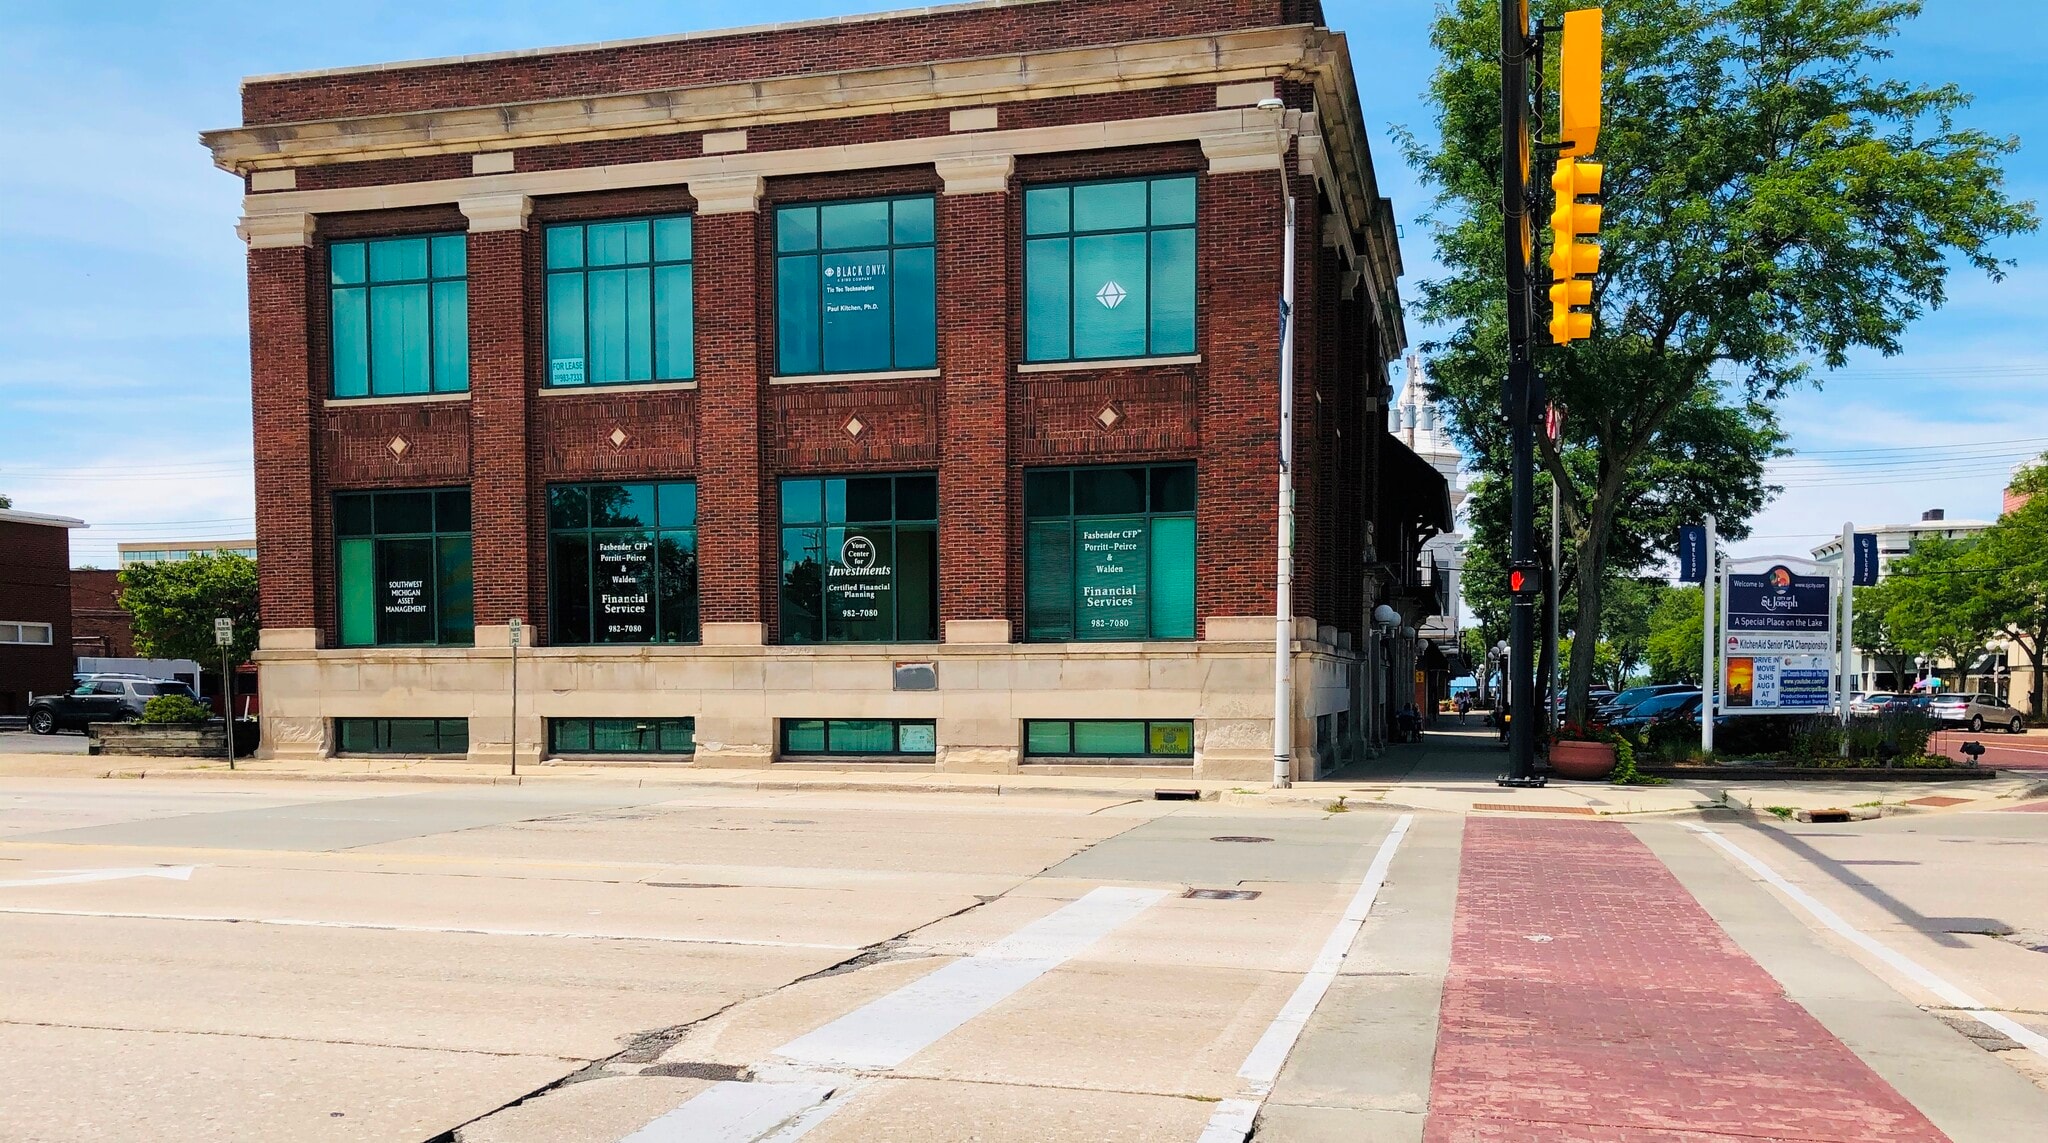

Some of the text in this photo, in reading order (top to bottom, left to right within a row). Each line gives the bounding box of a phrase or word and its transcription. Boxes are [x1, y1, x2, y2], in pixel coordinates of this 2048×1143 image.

[836, 264, 886, 277] BLACK ONYX
[553, 361, 583, 371] FOR LEASE
[1083, 531, 1120, 540] Fasbender
[599, 543, 632, 551] Fasbender
[1084, 543, 1137, 552] Porritt-Peirce
[600, 554, 647, 562] Porritt-Peirce
[1106, 553, 1113, 562] &
[621, 564, 627, 573] &
[828, 566, 891, 576] Investments
[1096, 564, 1124, 573] Walden
[611, 575, 636, 583] Walden
[389, 581, 423, 589] SOUTHWEST
[828, 583, 891, 591] Certified Financial
[1733, 580, 1758, 588] Welcome
[391, 589, 421, 597] MICHIGAN
[844, 590, 875, 599] Planning
[1083, 585, 1137, 596] Financial
[397, 597, 414, 605] ASSET
[601, 593, 649, 604] Financial
[1087, 596, 1133, 607] Services
[1772, 595, 1798, 611] Joseph
[385, 605, 427, 613] MANAGEMENT
[604, 603, 646, 614] Services
[842, 609, 878, 617] 982-7080
[1091, 619, 1129, 628] 982-7080
[1735, 617, 1740, 625] A
[1741, 617, 1765, 627] Special
[1766, 618, 1785, 627] Place
[1795, 618, 1807, 627] the
[1807, 619, 1823, 627] Lake
[608, 625, 642, 633] 982-7080
[1739, 640, 1828, 651] KitchenAid Senior PGA Championship
